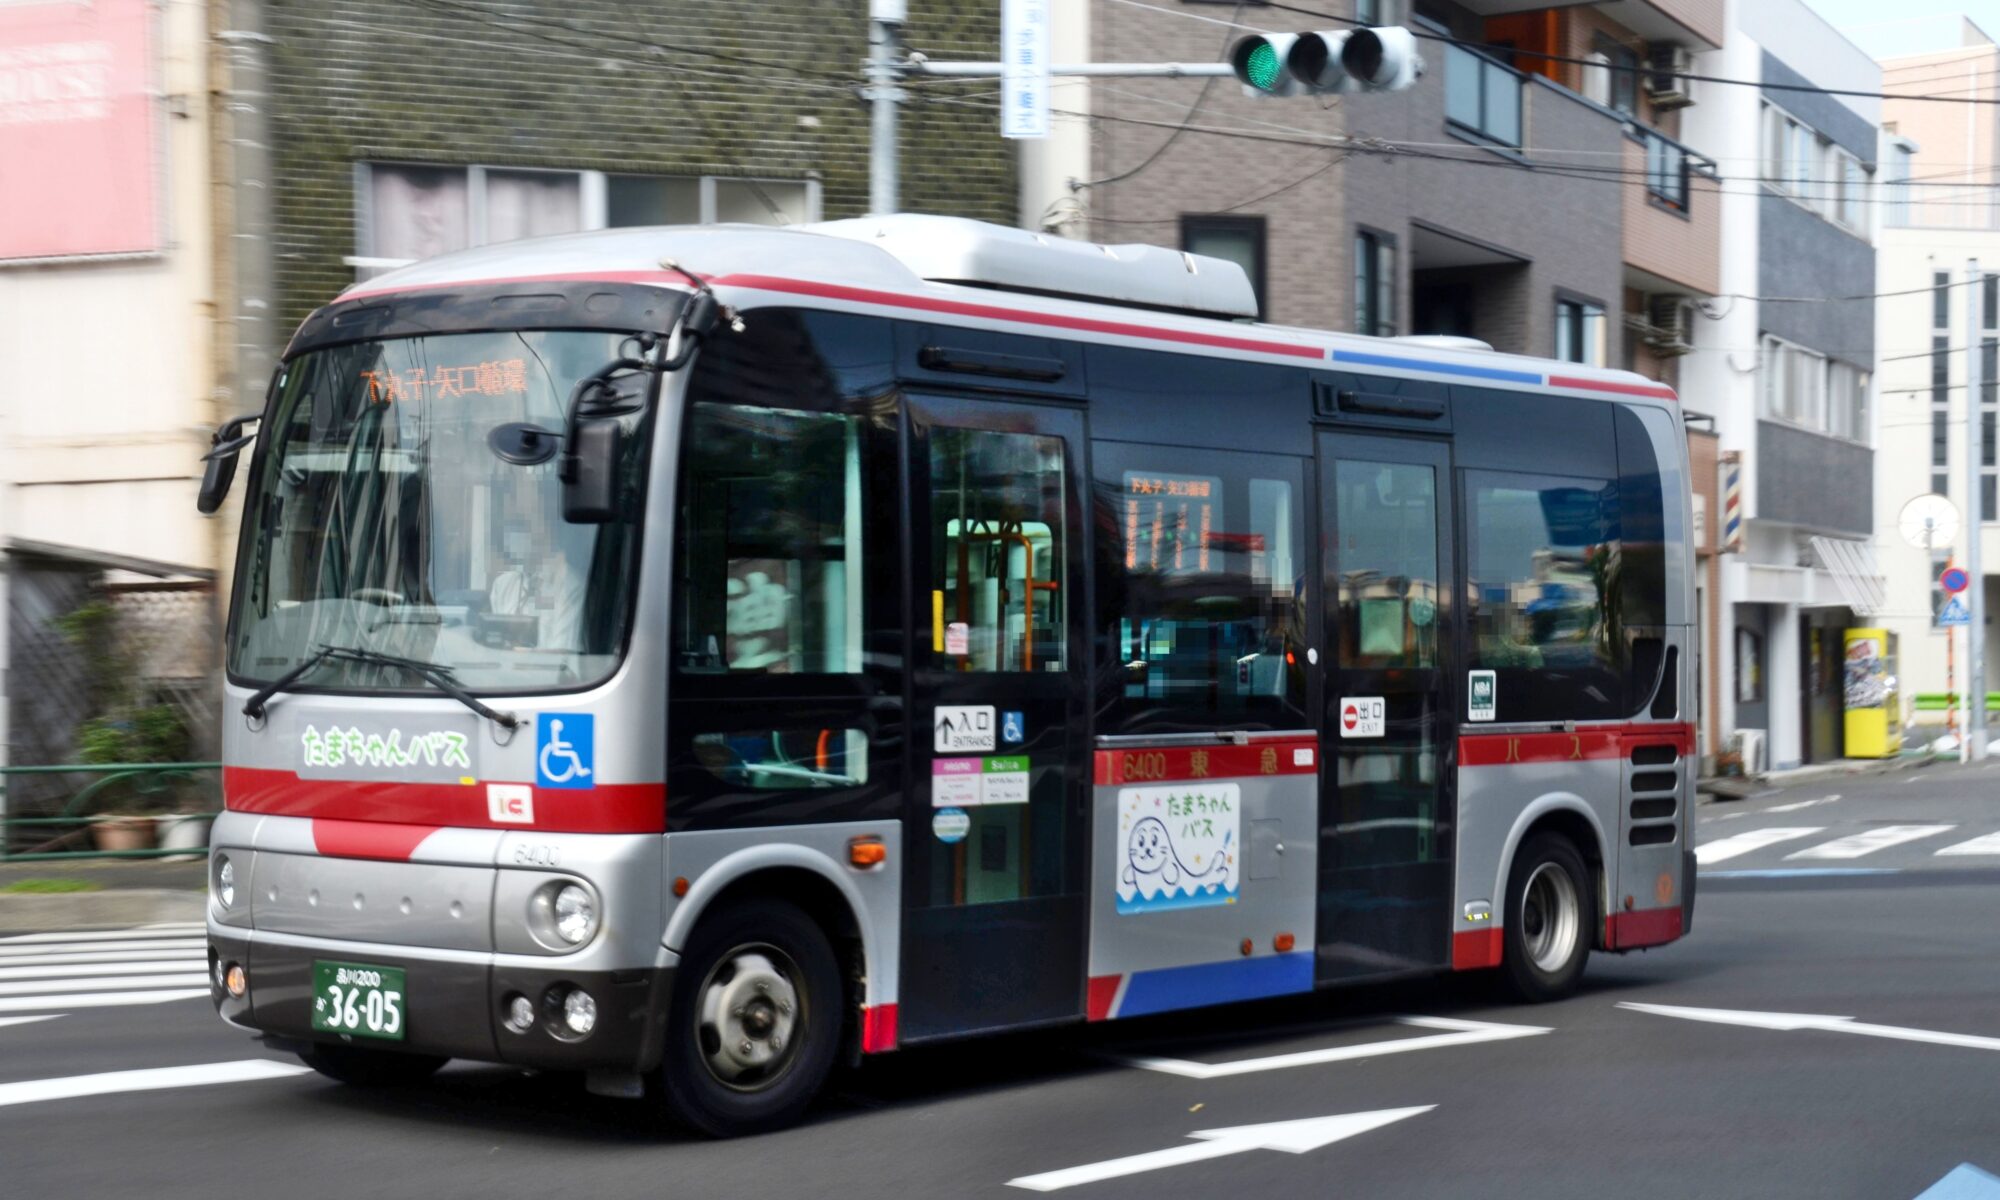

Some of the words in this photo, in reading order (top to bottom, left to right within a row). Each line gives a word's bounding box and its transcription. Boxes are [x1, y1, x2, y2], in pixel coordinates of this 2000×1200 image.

[1360, 702, 1381, 719] 出口
[958, 711, 987, 732] 入口
[1362, 722, 1379, 733] EXIT
[301, 724, 471, 769] たまちゃんバス
[1166, 791, 1233, 817] たまちゃん
[1181, 818, 1215, 838] バス
[327, 985, 401, 1033] 36-05
